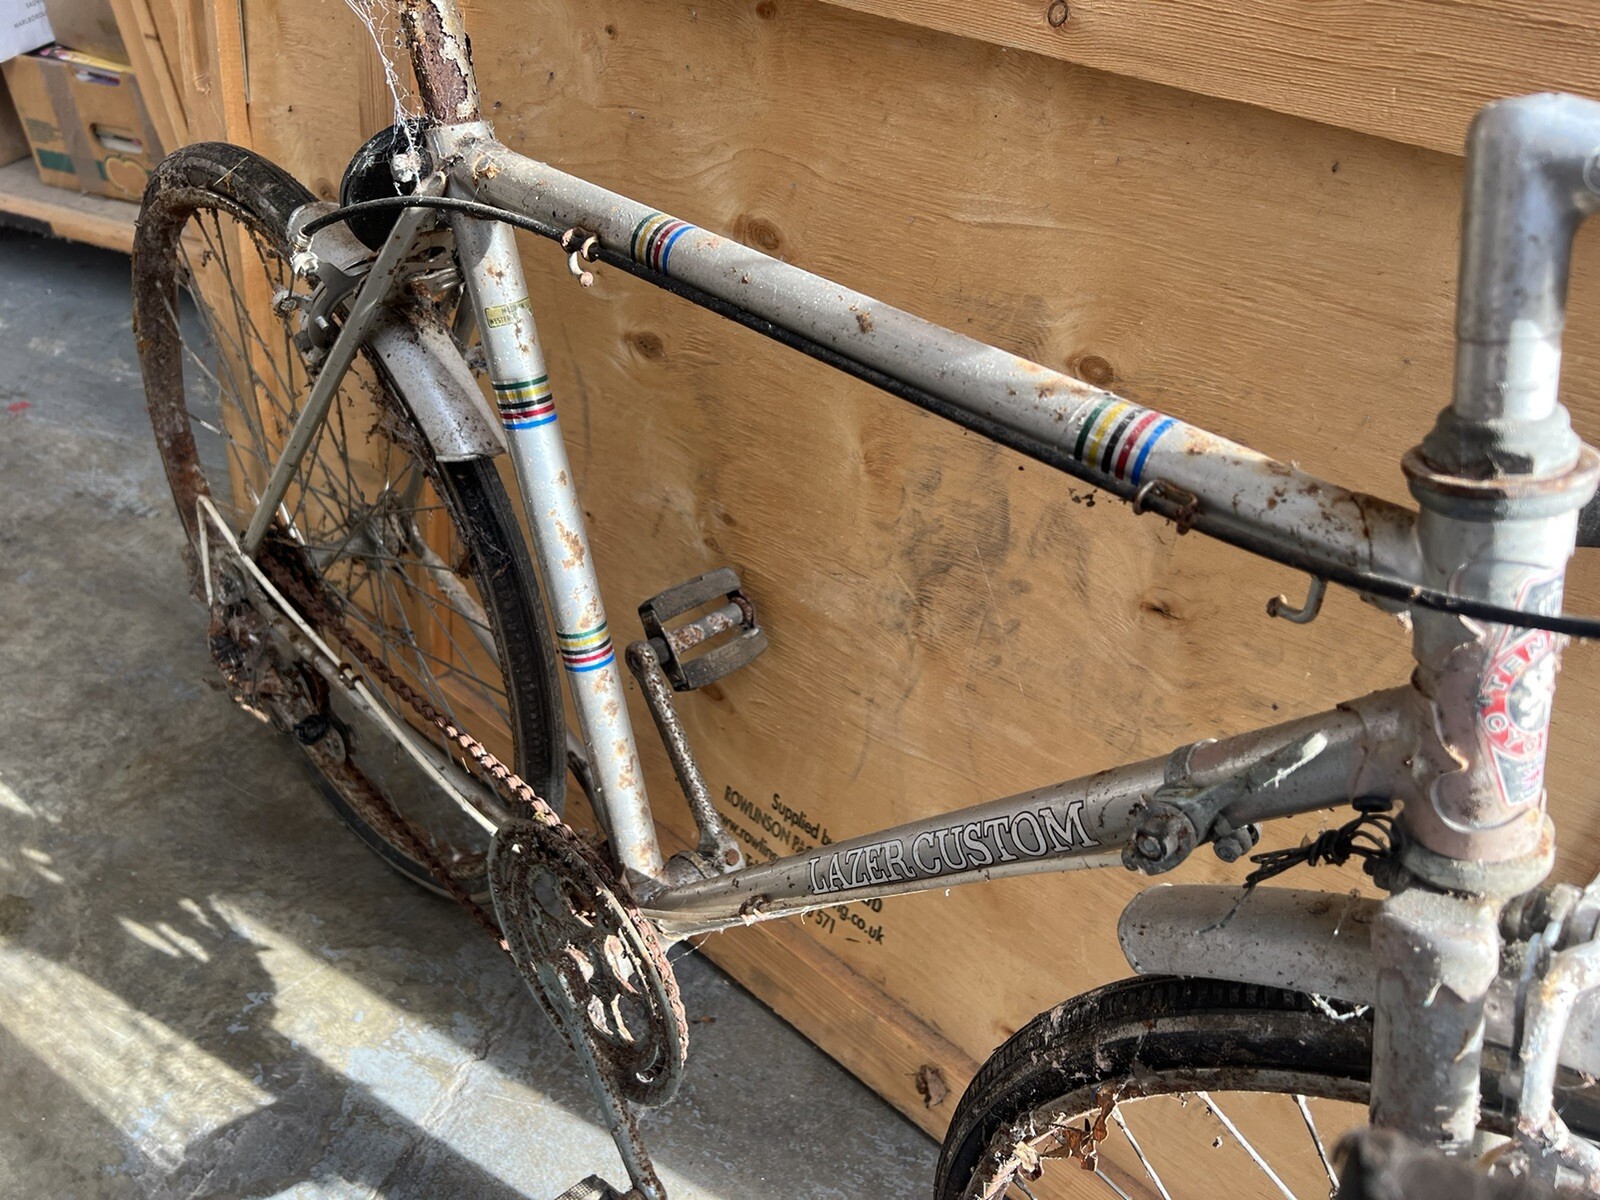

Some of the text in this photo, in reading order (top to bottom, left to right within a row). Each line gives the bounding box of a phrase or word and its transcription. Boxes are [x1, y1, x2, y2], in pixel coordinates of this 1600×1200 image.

[723, 785, 791, 846] ROWLINSON
[771, 793, 834, 845] Supplied b
[808, 801, 1101, 896] LAZER CUSTOM
